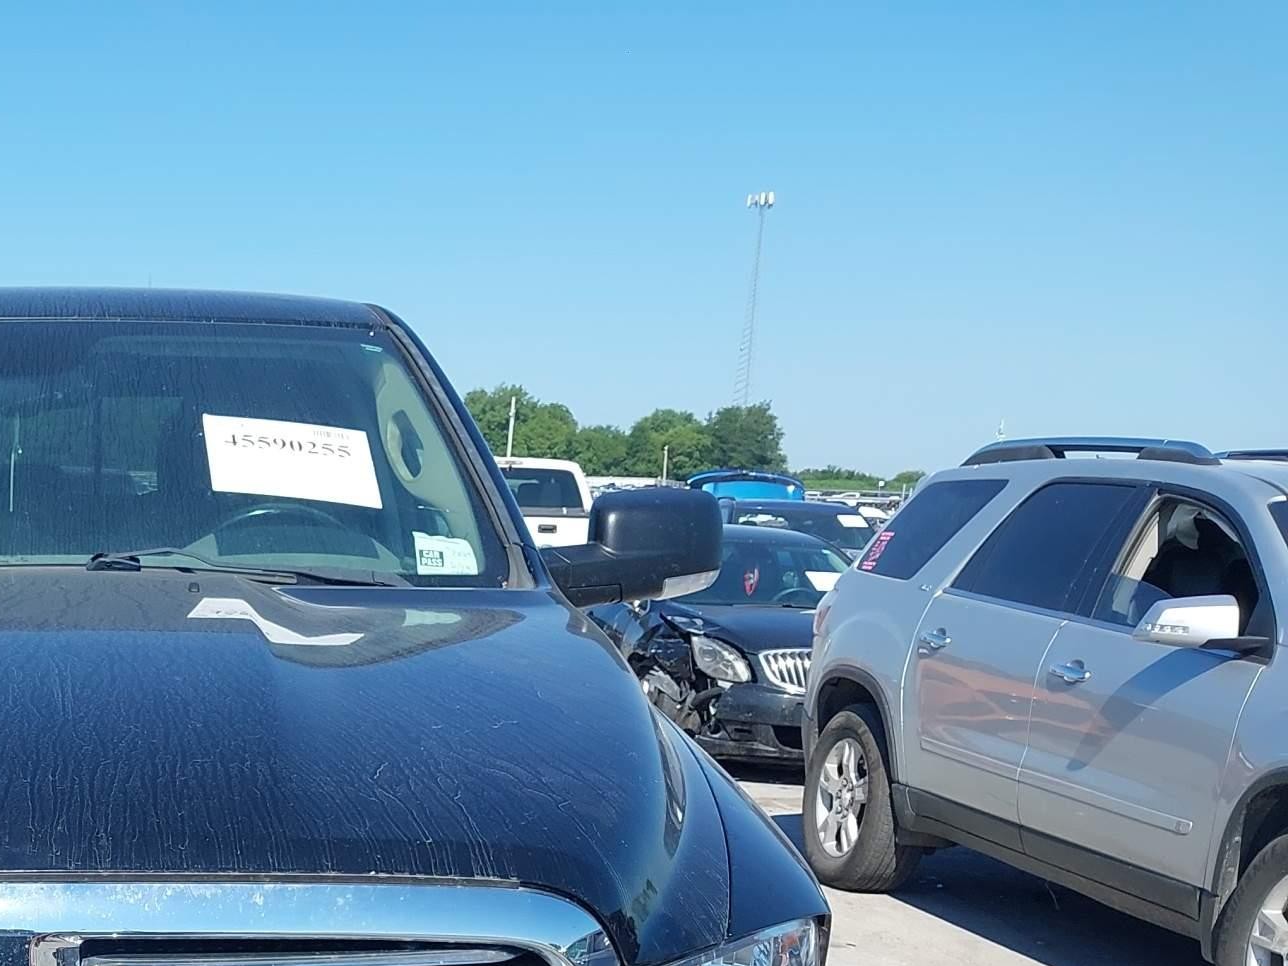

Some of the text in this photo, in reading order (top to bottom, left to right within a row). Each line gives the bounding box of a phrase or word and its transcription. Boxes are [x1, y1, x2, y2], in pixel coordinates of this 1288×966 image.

[224, 434, 351, 458] 45590255
[423, 550, 440, 559] CAR
[421, 557, 443, 567] PASS
